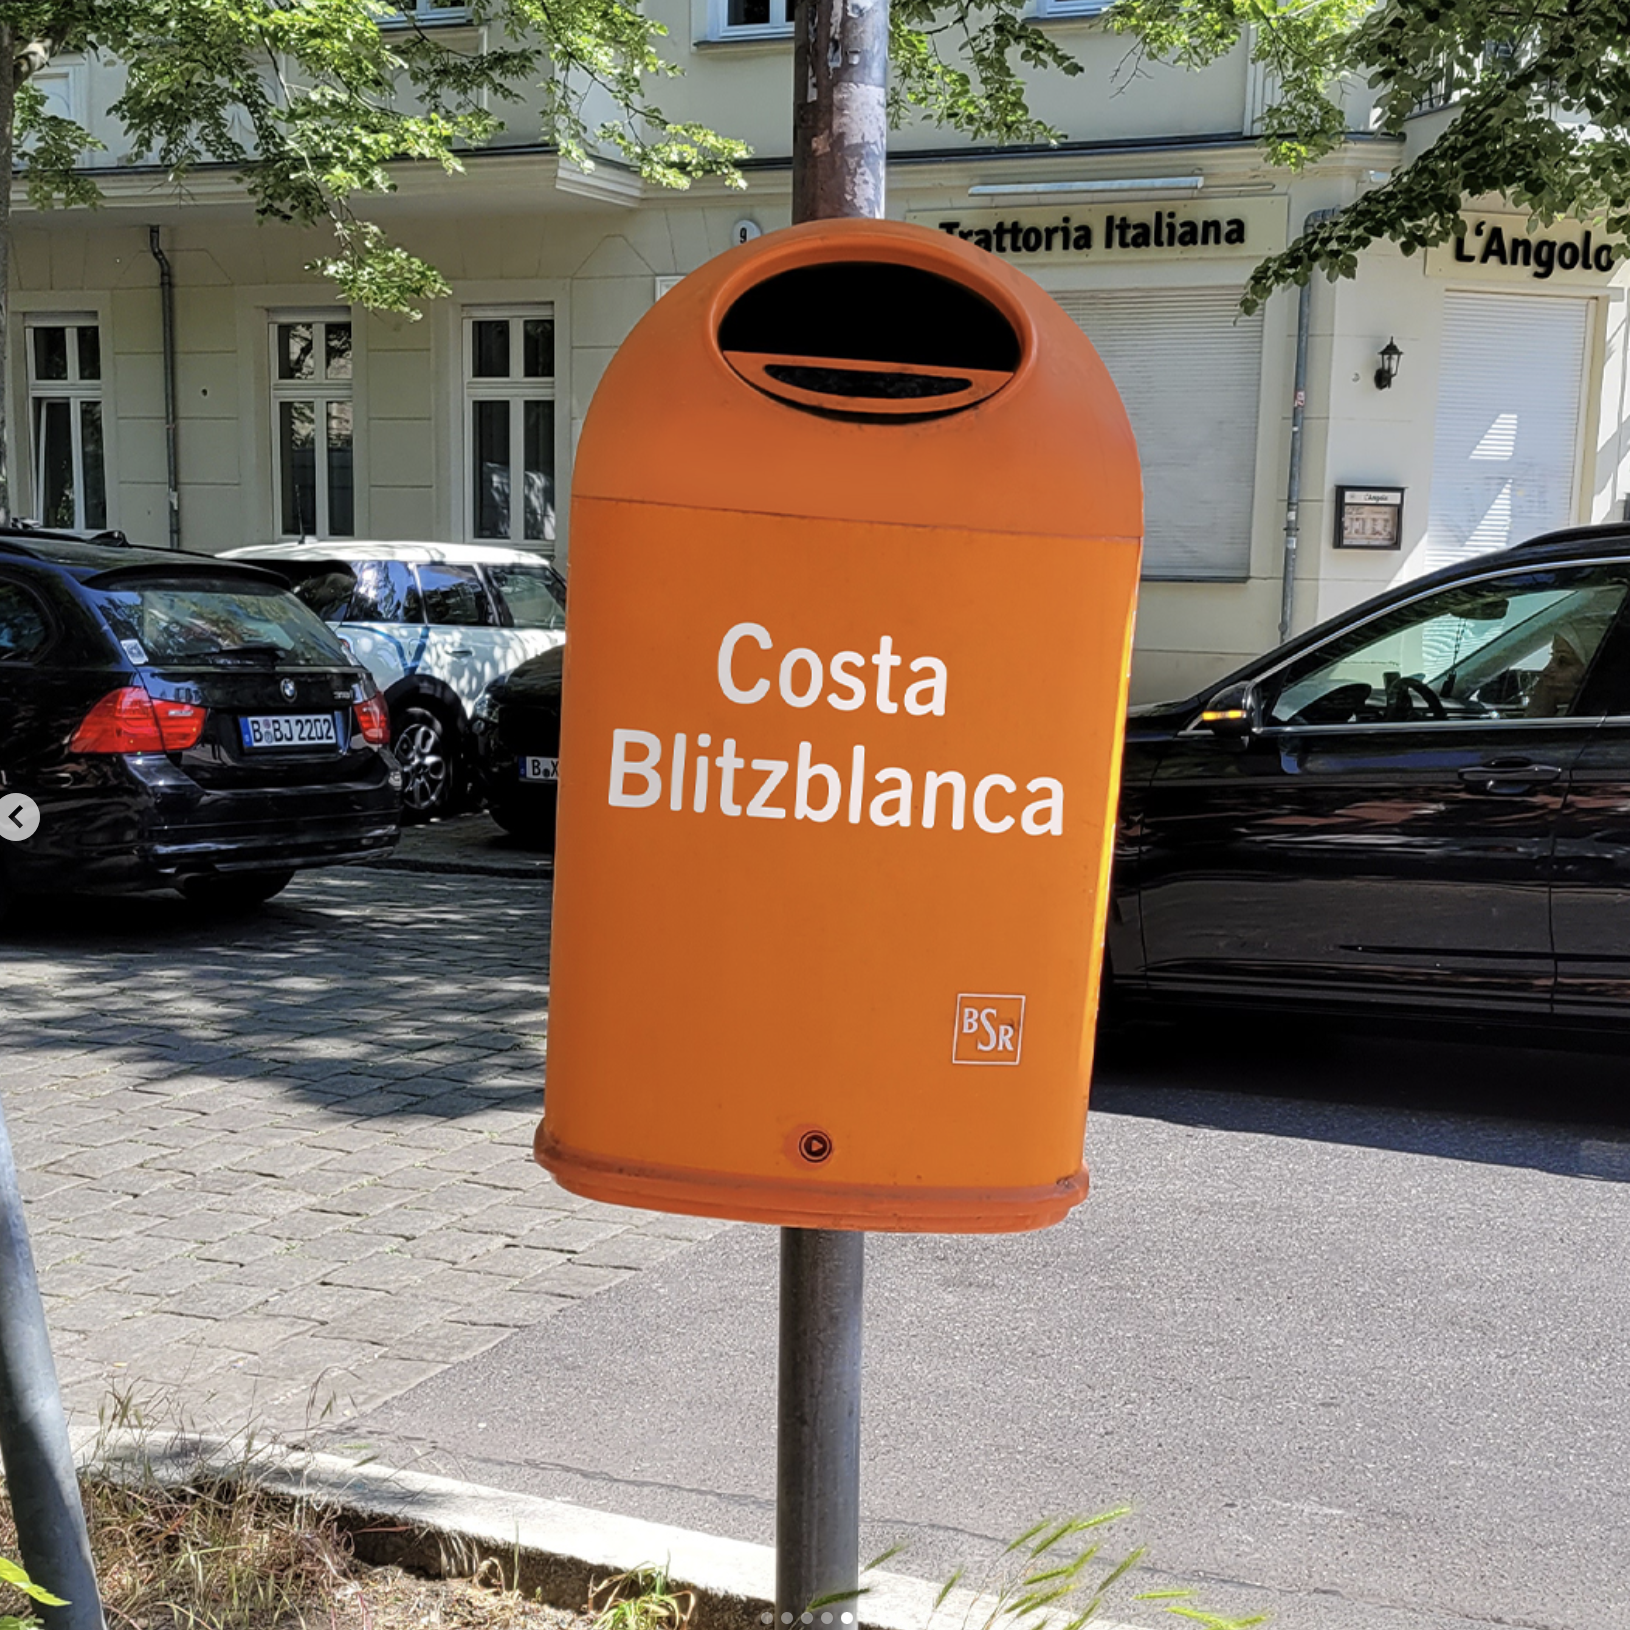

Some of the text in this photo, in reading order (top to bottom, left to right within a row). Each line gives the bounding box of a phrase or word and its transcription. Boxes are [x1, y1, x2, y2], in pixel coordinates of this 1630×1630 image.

[740, 227, 747, 244] 9
[939, 211, 1245, 253] Trattoria Italiana
[1455, 211, 1616, 279] L'Angolo
[717, 622, 948, 717] Costa
[608, 728, 1065, 836] Blitzblanca
[962, 1007, 1014, 1052] BSR
